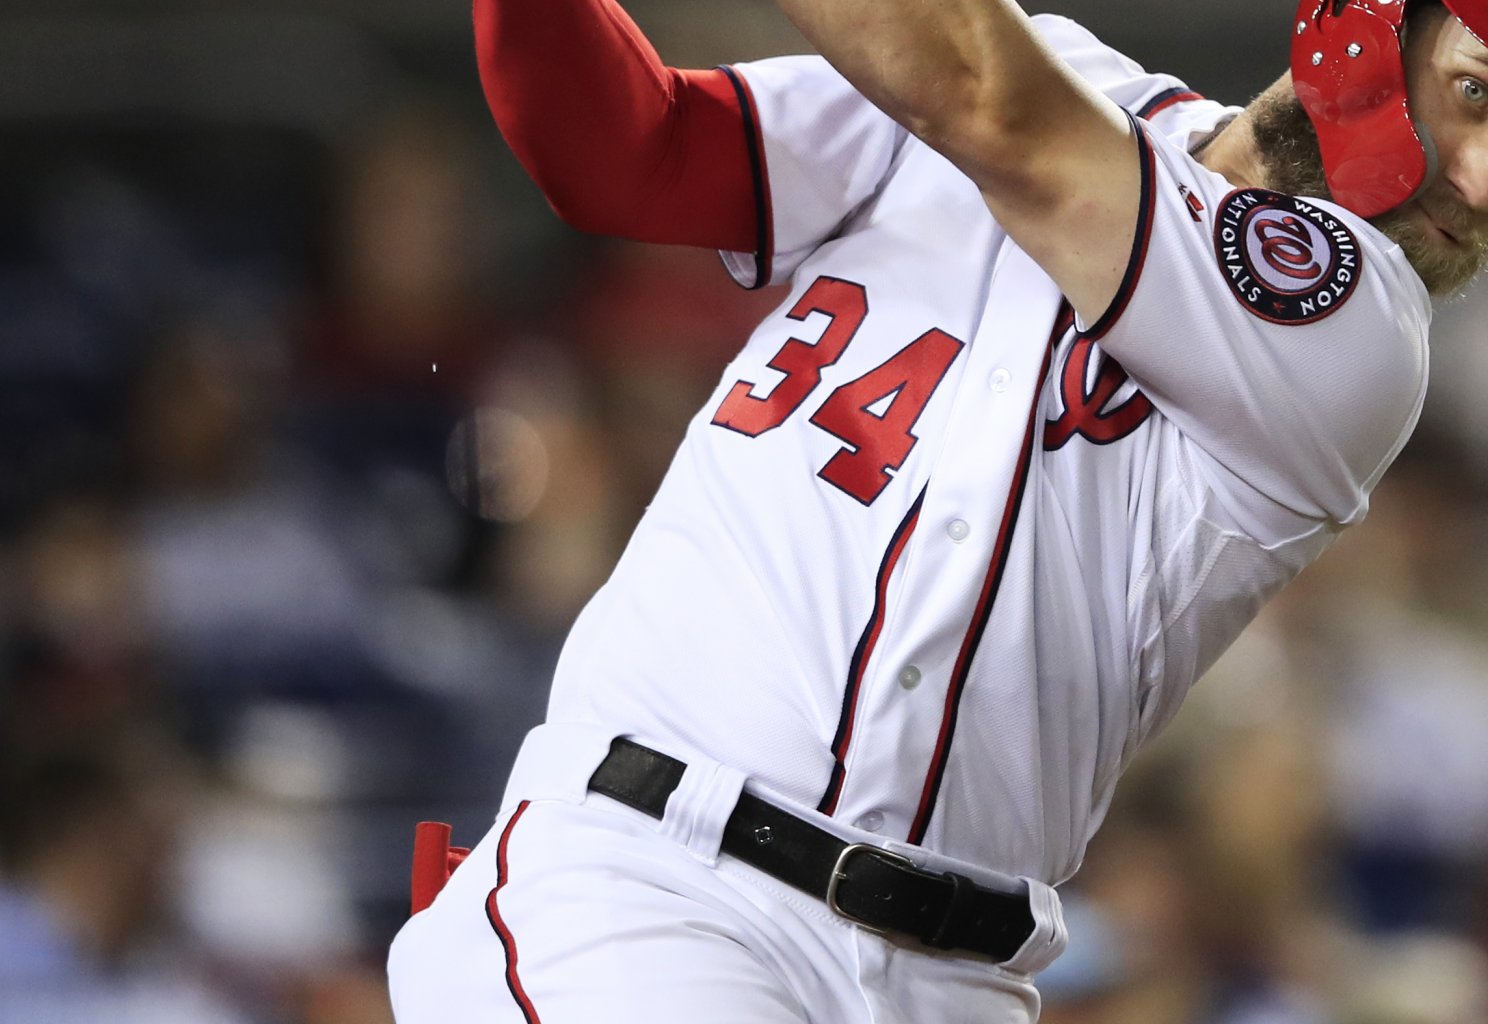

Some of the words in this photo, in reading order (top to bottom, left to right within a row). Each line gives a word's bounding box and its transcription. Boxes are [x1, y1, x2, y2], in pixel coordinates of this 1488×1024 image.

[1221, 192, 1262, 303] NATIONALS
[1294, 200, 1356, 316] WASHINGTON
[710, 275, 967, 507] 34
